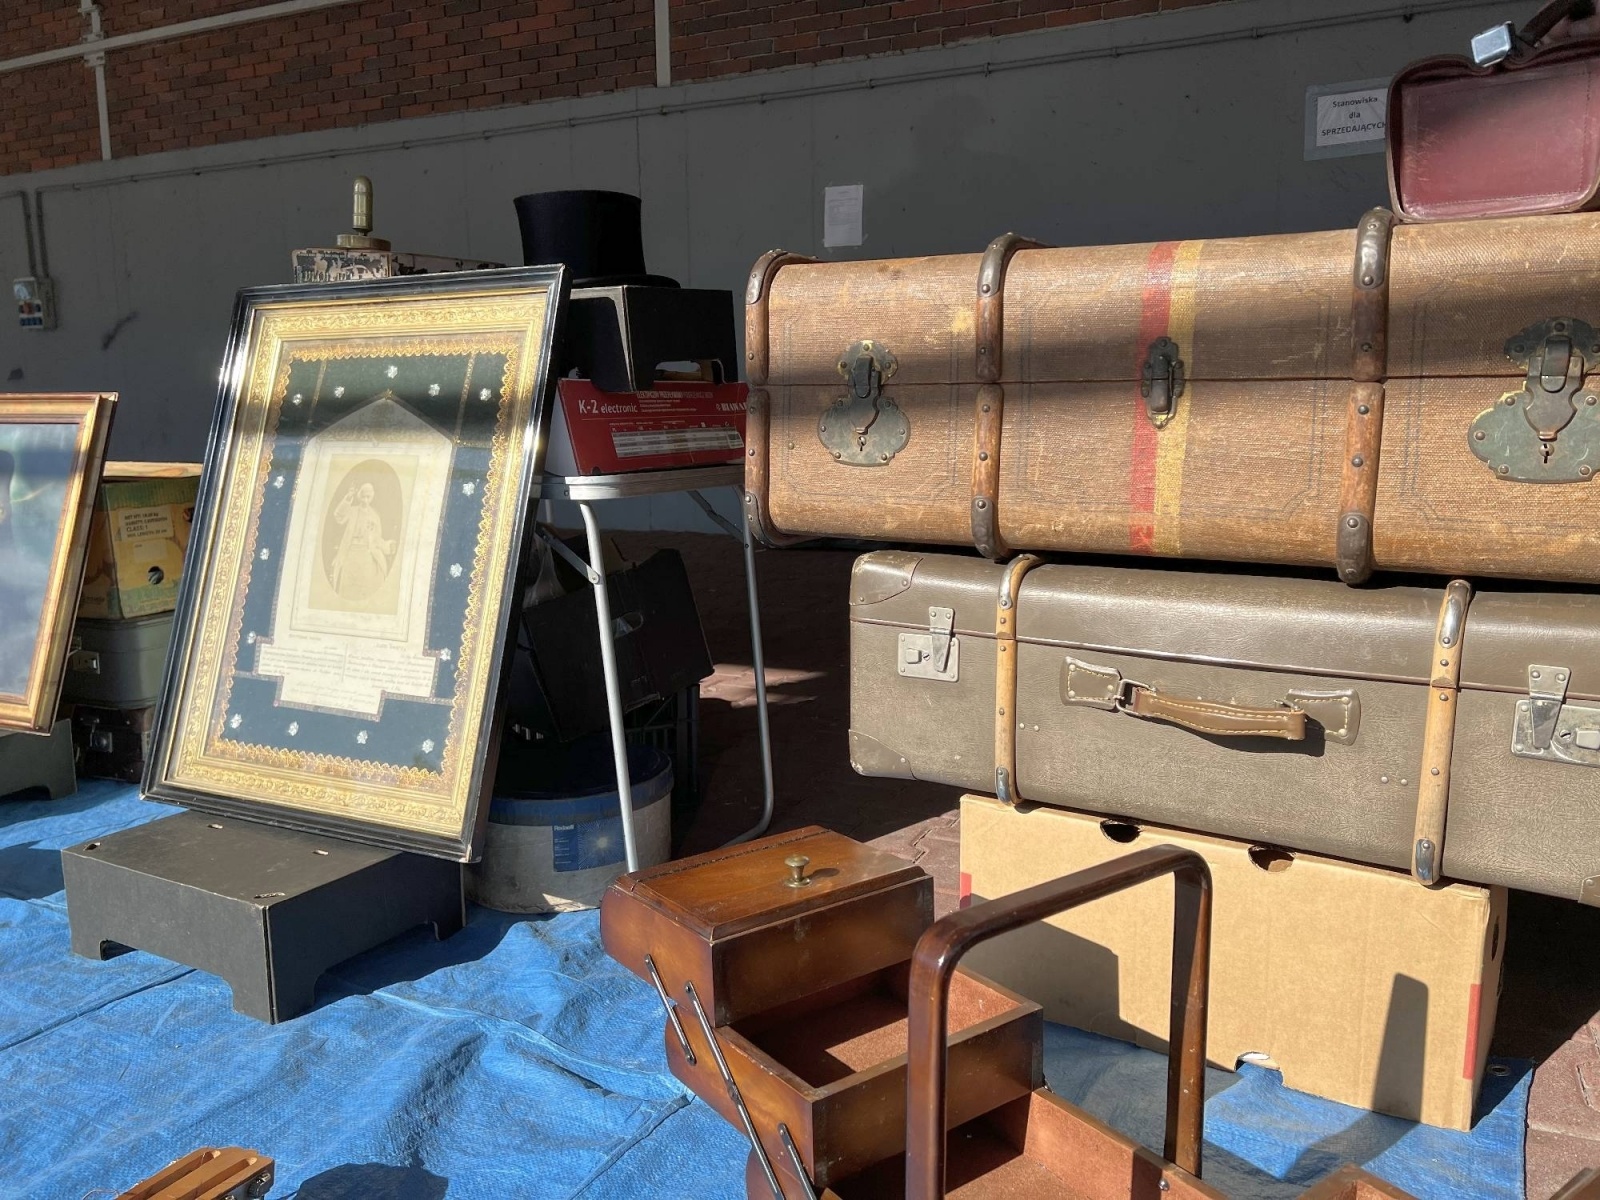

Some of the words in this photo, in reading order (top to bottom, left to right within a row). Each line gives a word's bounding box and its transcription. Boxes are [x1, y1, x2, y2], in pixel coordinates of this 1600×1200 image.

[1332, 96, 1378, 108] Stanowiska
[1348, 111, 1361, 119] dla
[578, 399, 599, 414] K-2
[600, 402, 639, 415] electronic
